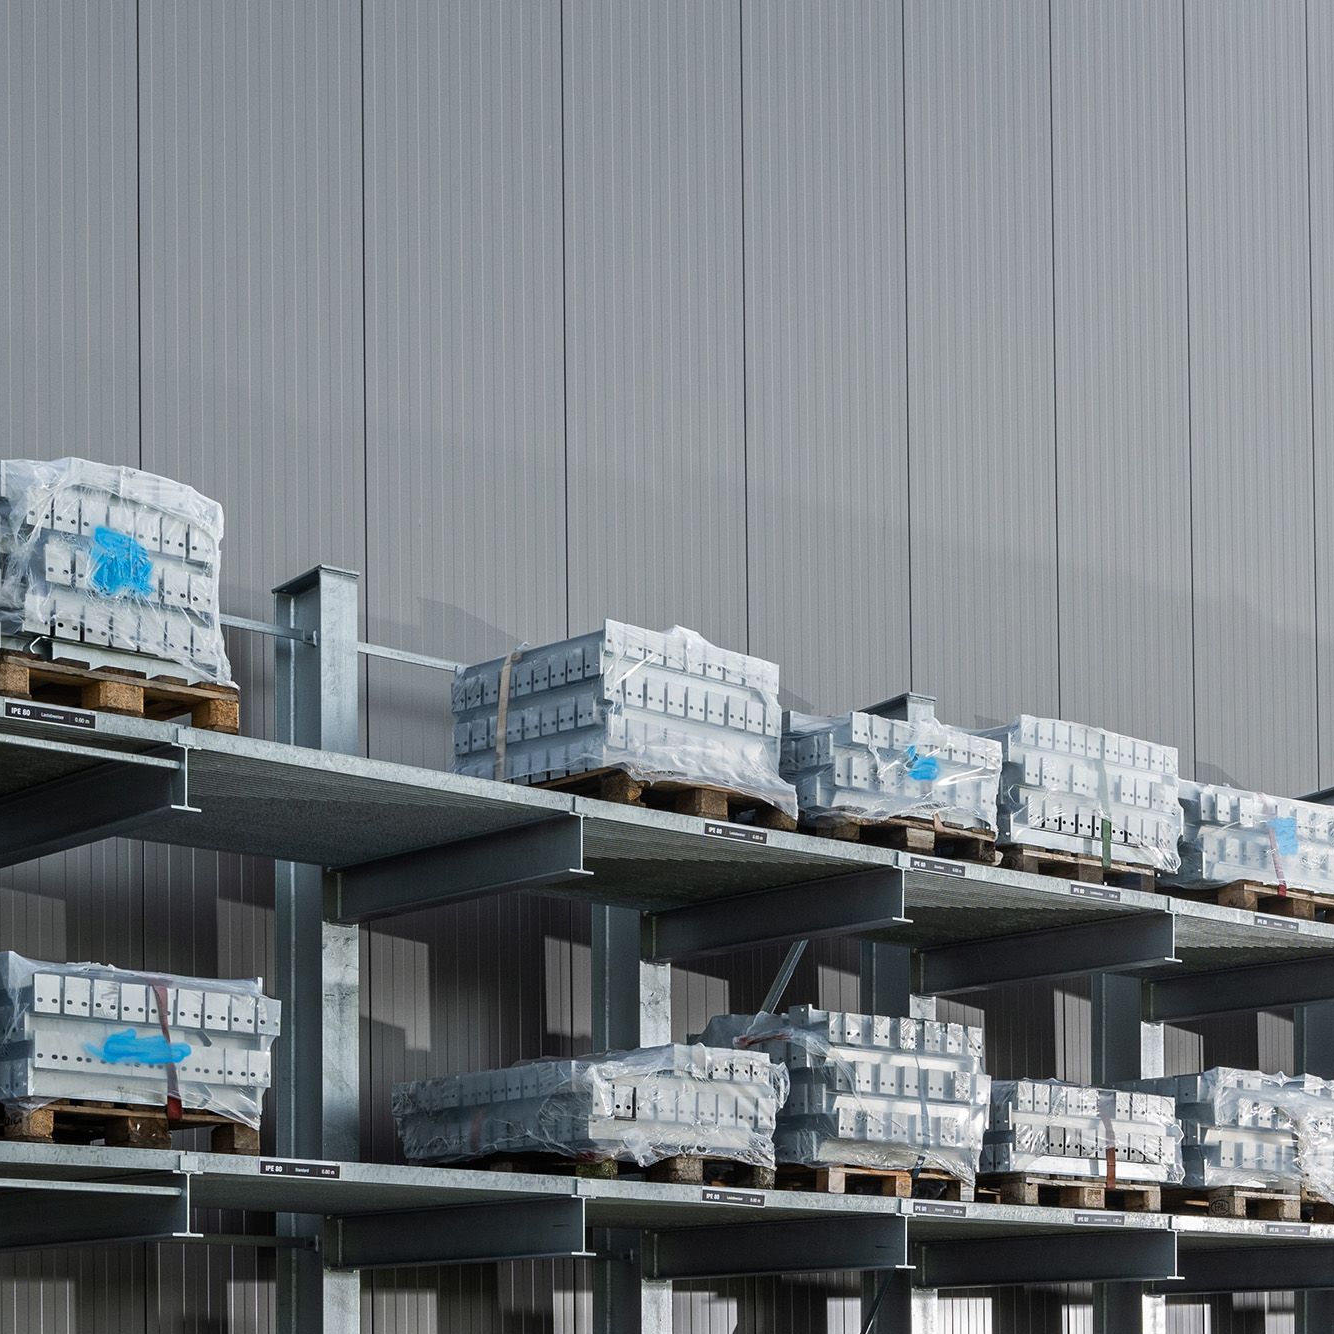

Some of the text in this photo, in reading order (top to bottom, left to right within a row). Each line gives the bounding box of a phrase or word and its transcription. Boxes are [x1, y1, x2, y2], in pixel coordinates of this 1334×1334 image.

[11, 707, 22, 715] IPE
[22, 708, 31, 717] 80
[265, 1164, 274, 1172] IPE
[274, 1165, 283, 1173] 80
